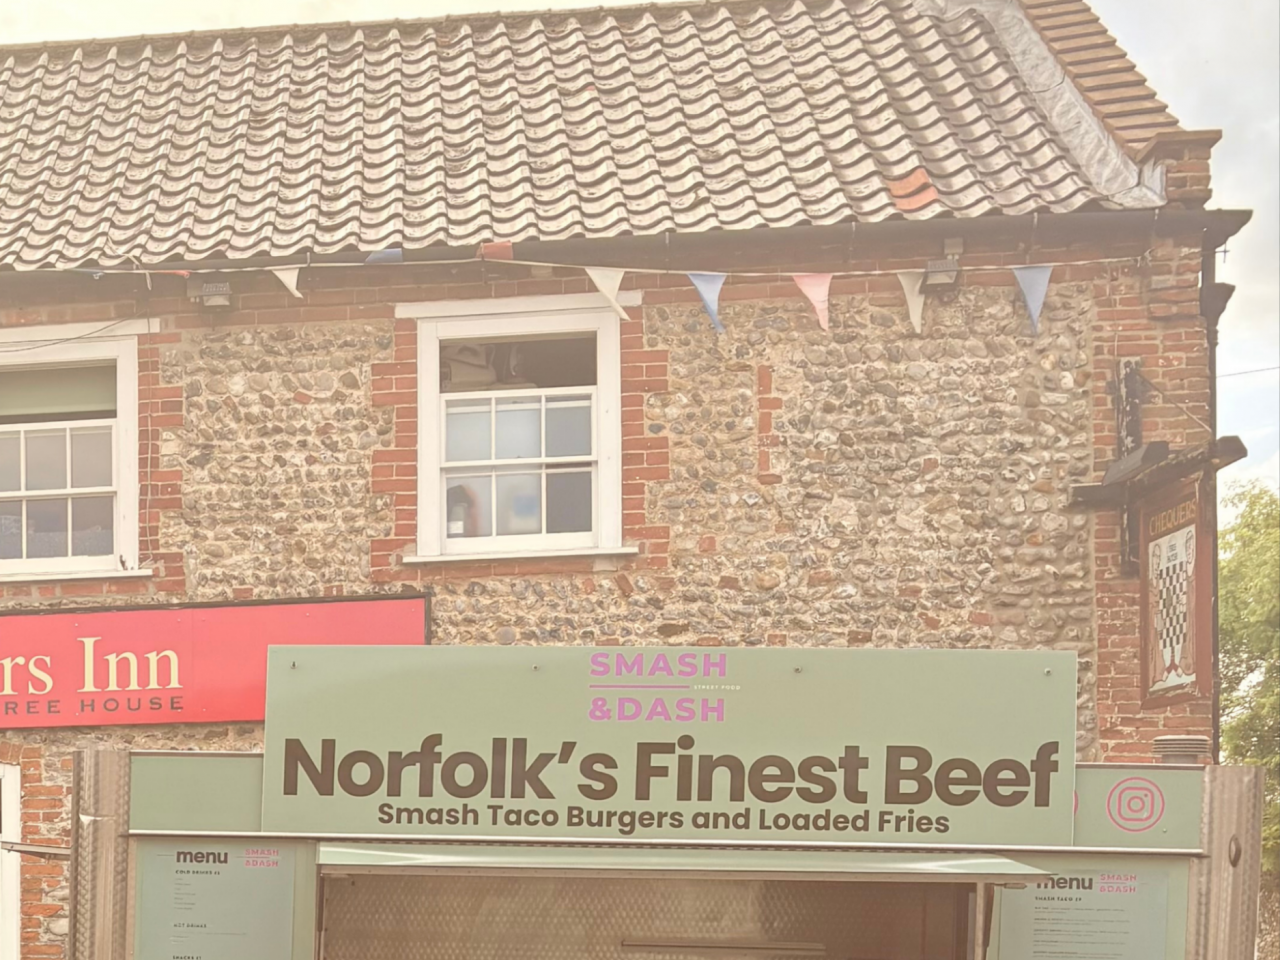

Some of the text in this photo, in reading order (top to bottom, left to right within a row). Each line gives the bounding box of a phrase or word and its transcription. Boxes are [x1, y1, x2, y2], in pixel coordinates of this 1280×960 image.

[1149, 498, 1196, 536] CHEQUERS
[76, 636, 184, 693] Inn
[590, 652, 727, 677] SMASH
[80, 695, 185, 713] HOUSE
[588, 697, 725, 722] &DASH
[635, 734, 869, 804] Finest
[884, 741, 1060, 807] Beef
[378, 802, 950, 836] Smash Taco Burgers and Loaded Fries
[176, 848, 279, 864] menu SMASH
[1036, 873, 1137, 890] menu SMASH
